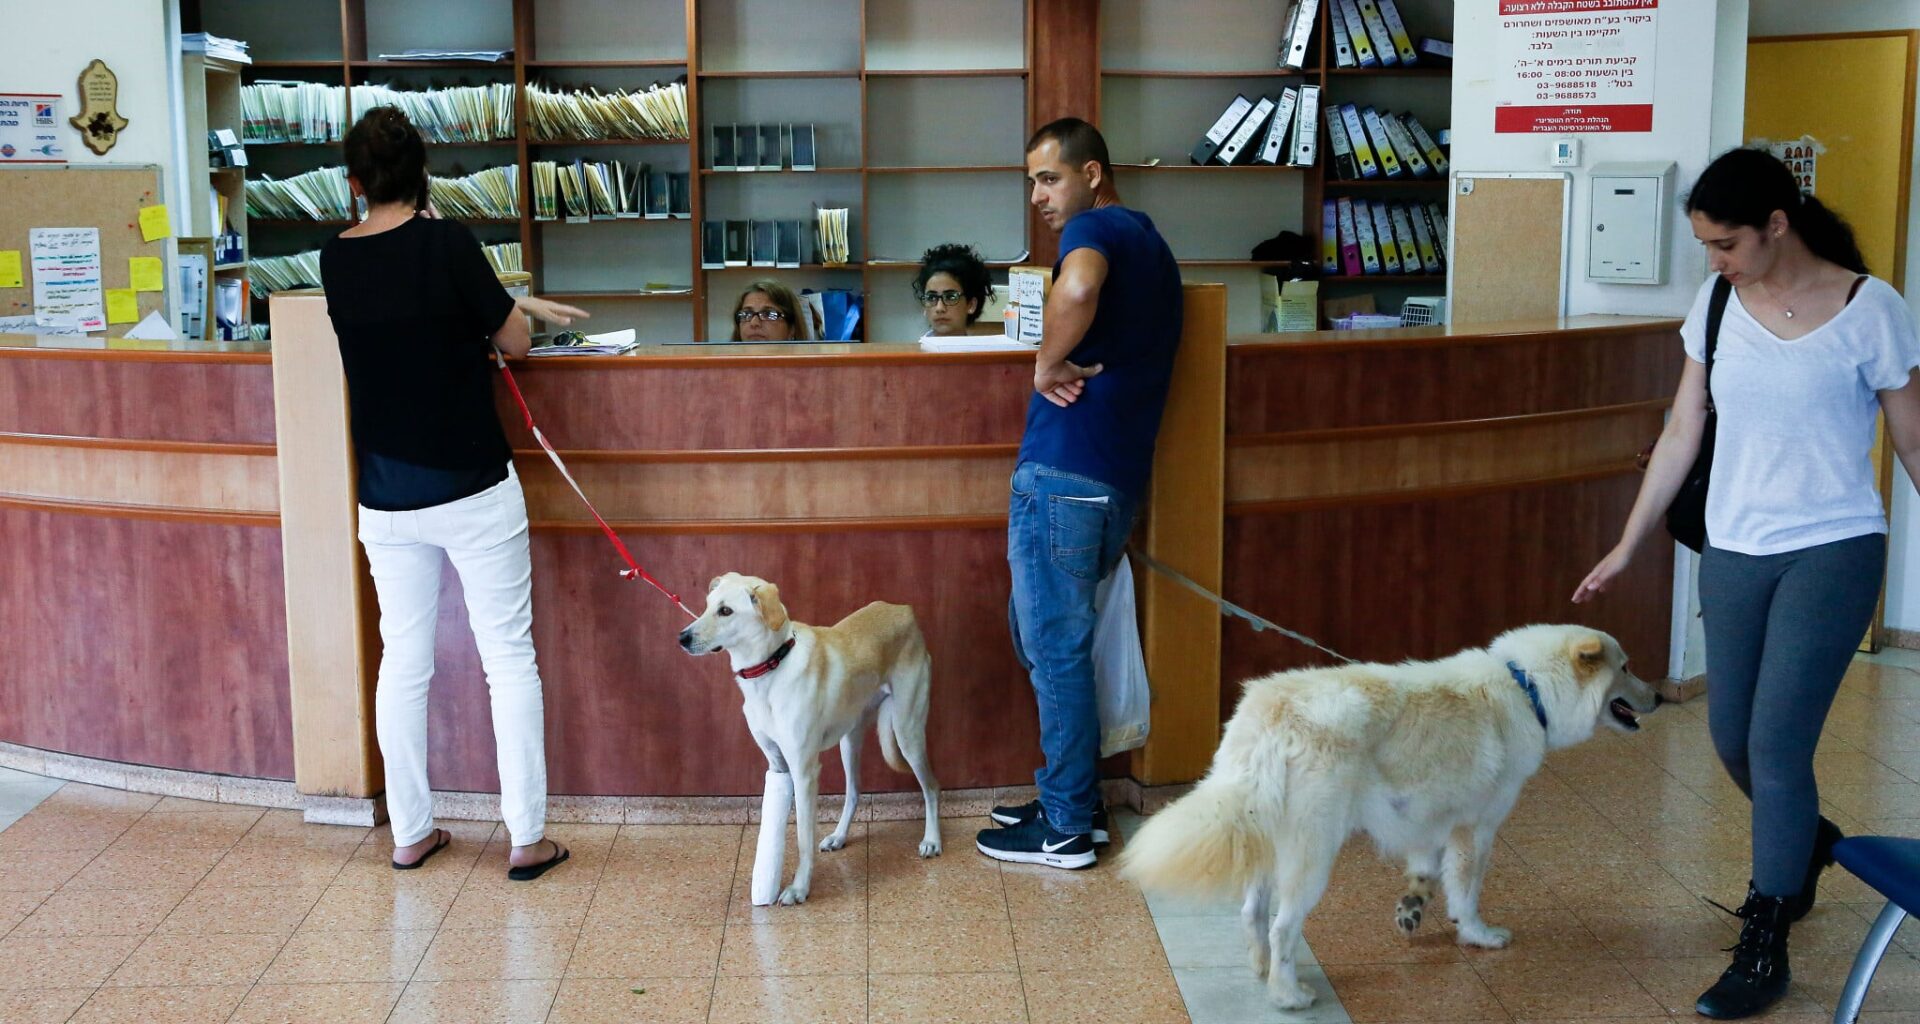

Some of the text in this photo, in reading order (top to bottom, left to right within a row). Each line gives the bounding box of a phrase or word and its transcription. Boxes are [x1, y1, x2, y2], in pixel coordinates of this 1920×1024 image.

[1531, 2, 1545, 10] ללא
[1548, 1, 1574, 11] הקבלה
[1577, 0, 1601, 8] בשטח
[1503, 4, 1529, 13] רצועה.
[1544, 18, 1591, 27] מאושפזים
[1623, 15, 1651, 24] ביקורי
[1532, 29, 1620, 40] יתקיימו בין השעות:
[1528, 42, 1553, 51] בלבד.
[1575, 58, 1602, 66] תורים
[1605, 57, 1637, 66] קביעת
[1517, 71, 1543, 79] 16:00
[1621, 69, 1634, 77] בין
[1536, 81, 1597, 89] 03-9688518
[1536, 92, 1597, 100] 03-9688573
